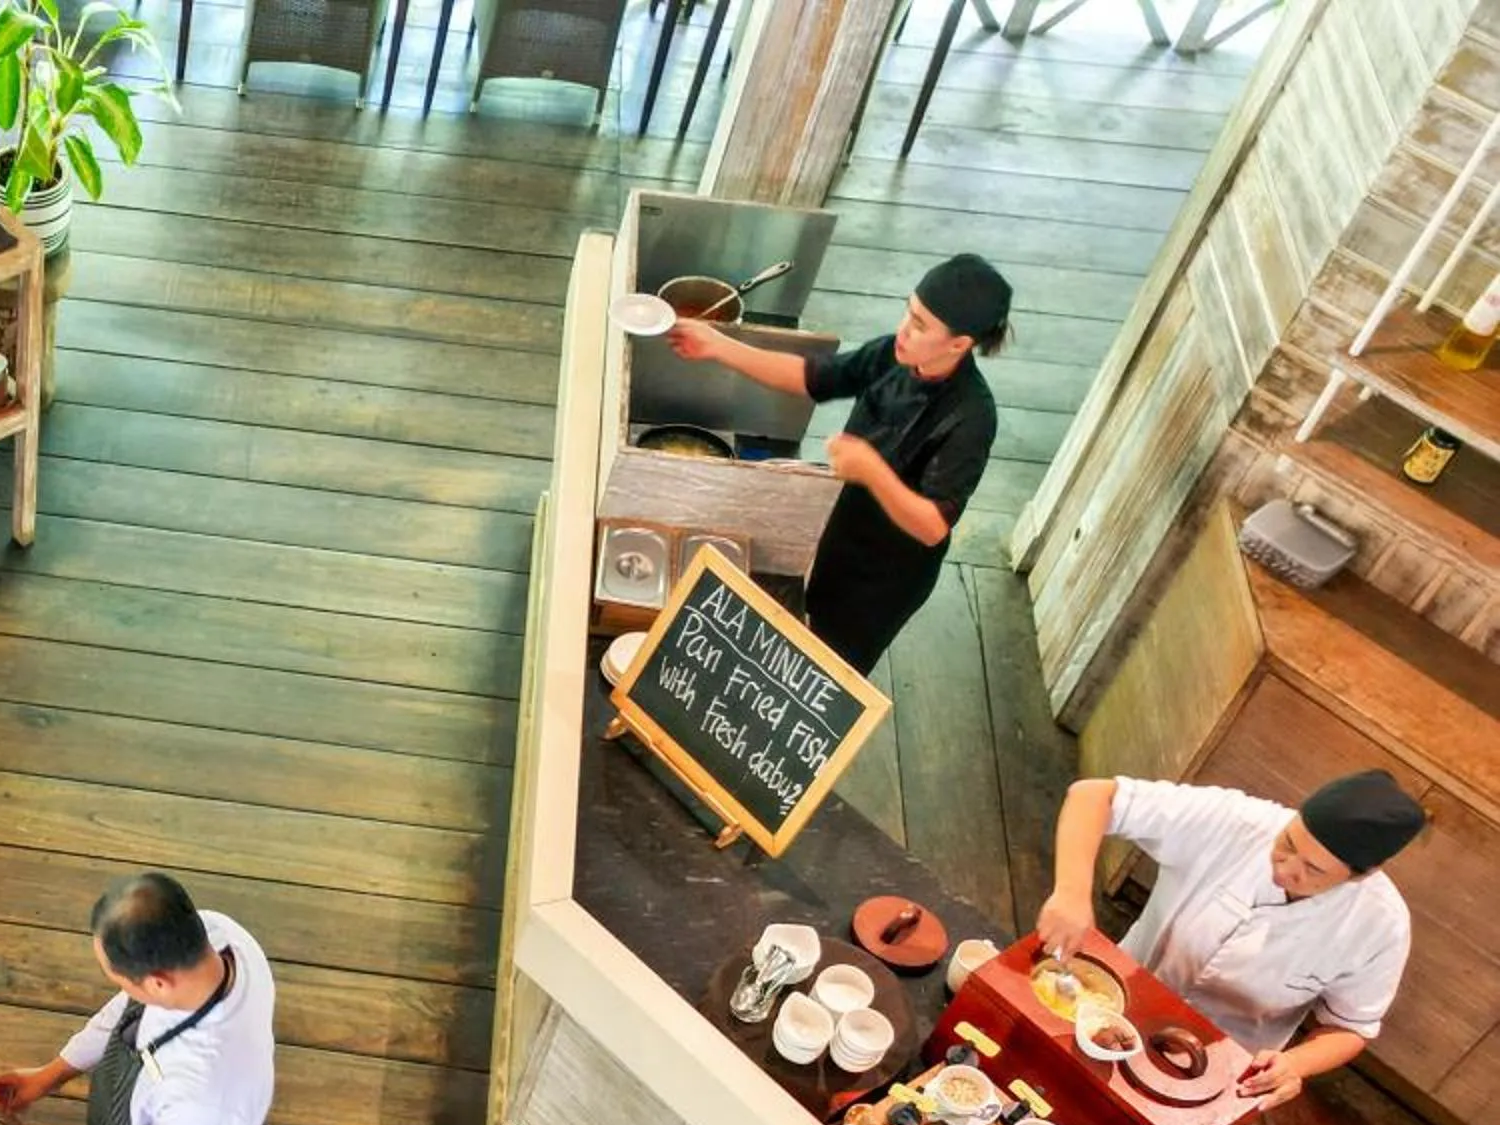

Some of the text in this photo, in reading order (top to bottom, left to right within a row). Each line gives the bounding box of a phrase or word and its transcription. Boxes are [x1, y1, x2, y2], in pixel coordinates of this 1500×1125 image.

[658, 656, 696, 711] with
[699, 695, 748, 760] Fresh
[675, 612, 723, 673] Pan
[723, 663, 790, 731] Fried
[748, 622, 841, 713] MINUTE
